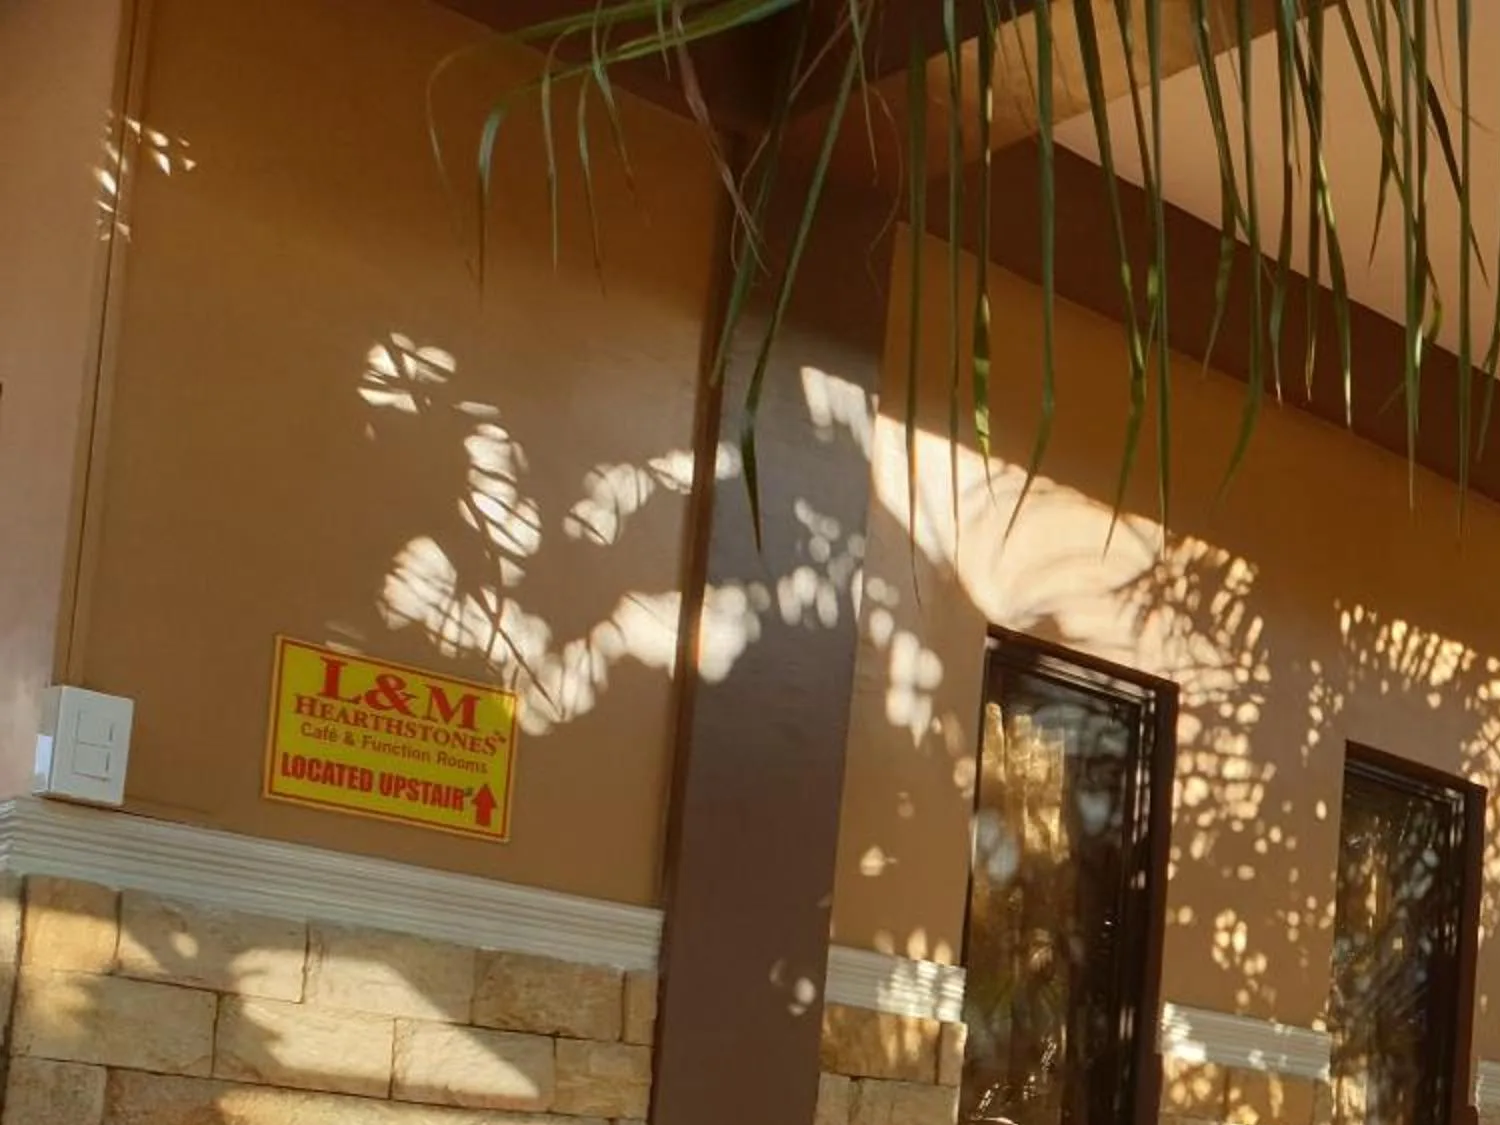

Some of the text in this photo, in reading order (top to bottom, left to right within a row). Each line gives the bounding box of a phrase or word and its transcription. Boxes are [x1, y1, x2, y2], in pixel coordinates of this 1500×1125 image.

[319, 655, 480, 732] L&M
[281, 751, 374, 793] LOCATED
[343, 731, 355, 746] &
[362, 735, 430, 763] Function
[437, 751, 488, 774] Rooms
